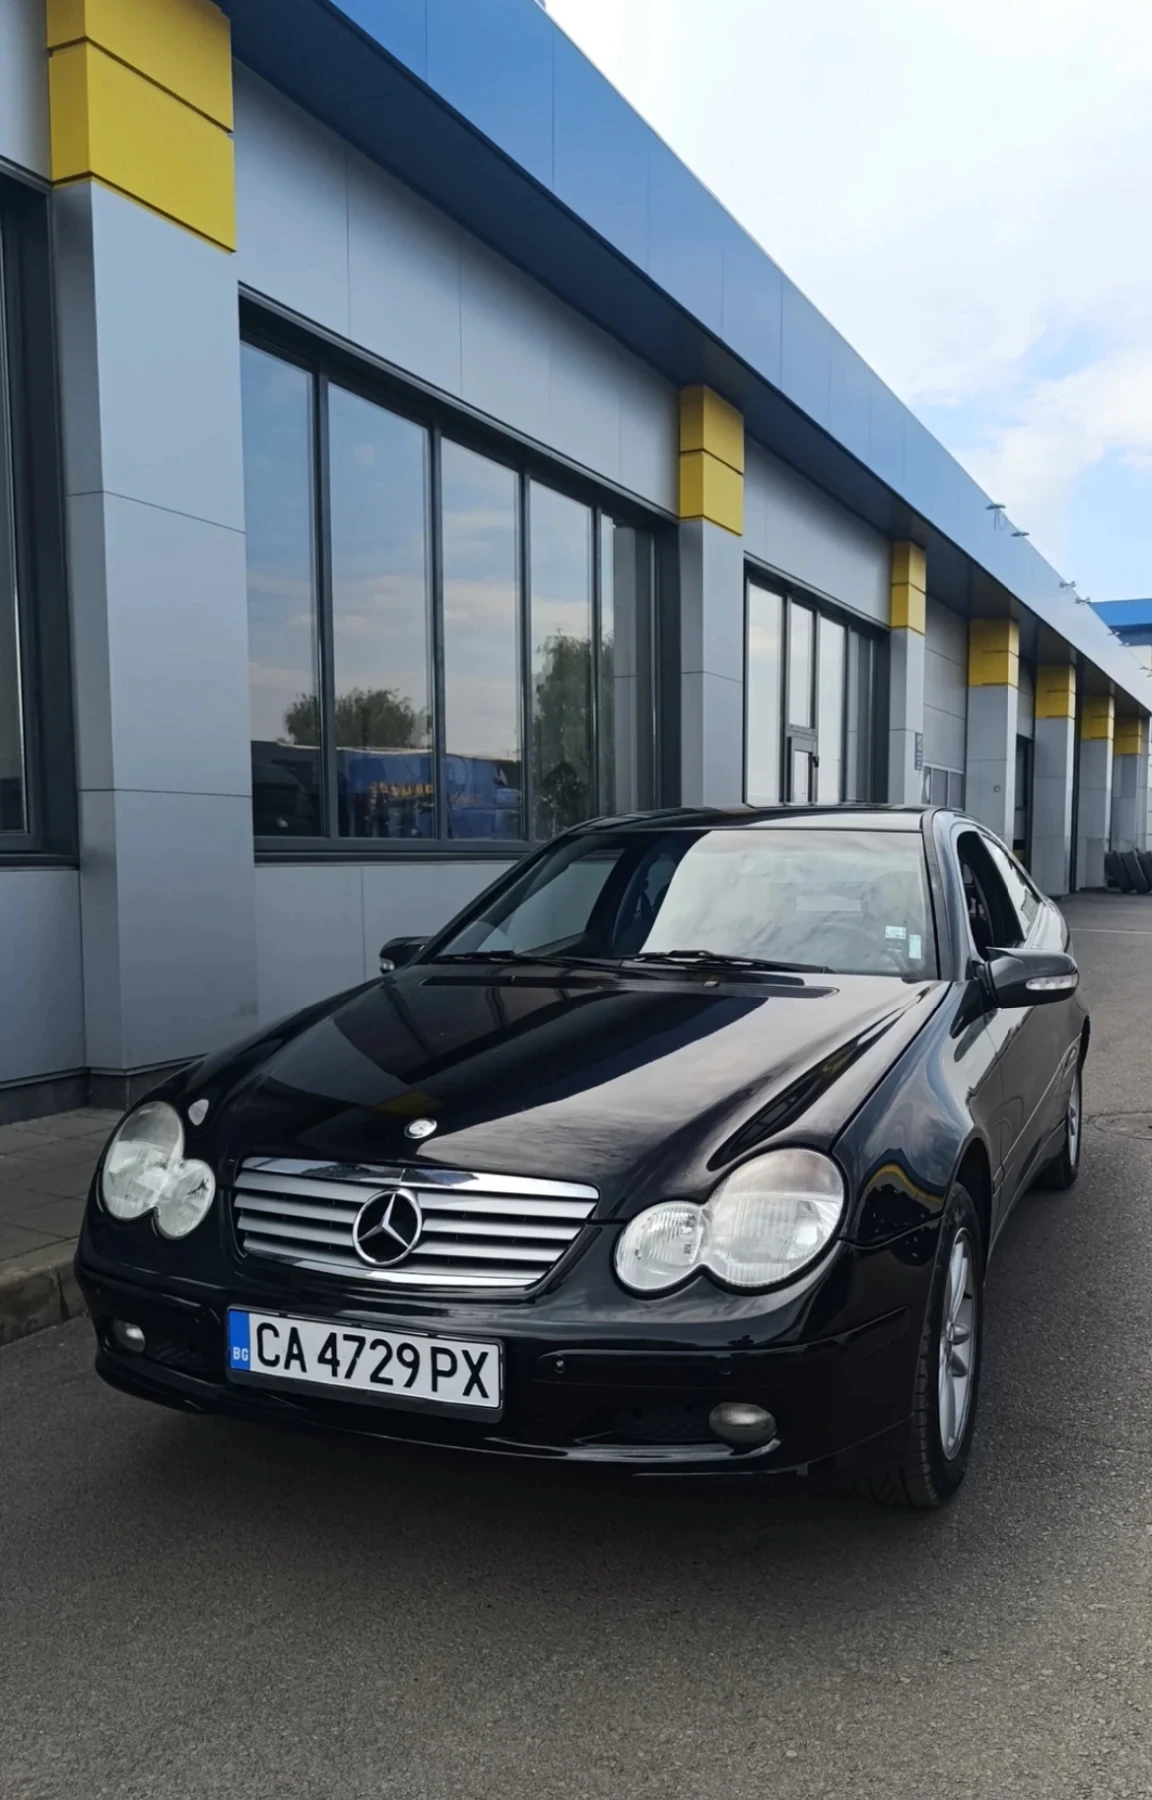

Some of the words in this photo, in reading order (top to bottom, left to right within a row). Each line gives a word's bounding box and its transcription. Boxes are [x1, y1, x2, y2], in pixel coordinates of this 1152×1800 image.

[233, 1346, 249, 1362] BG
[256, 1322, 307, 1373] CA
[317, 1332, 420, 1388] 4729
[430, 1346, 489, 1399] PX
